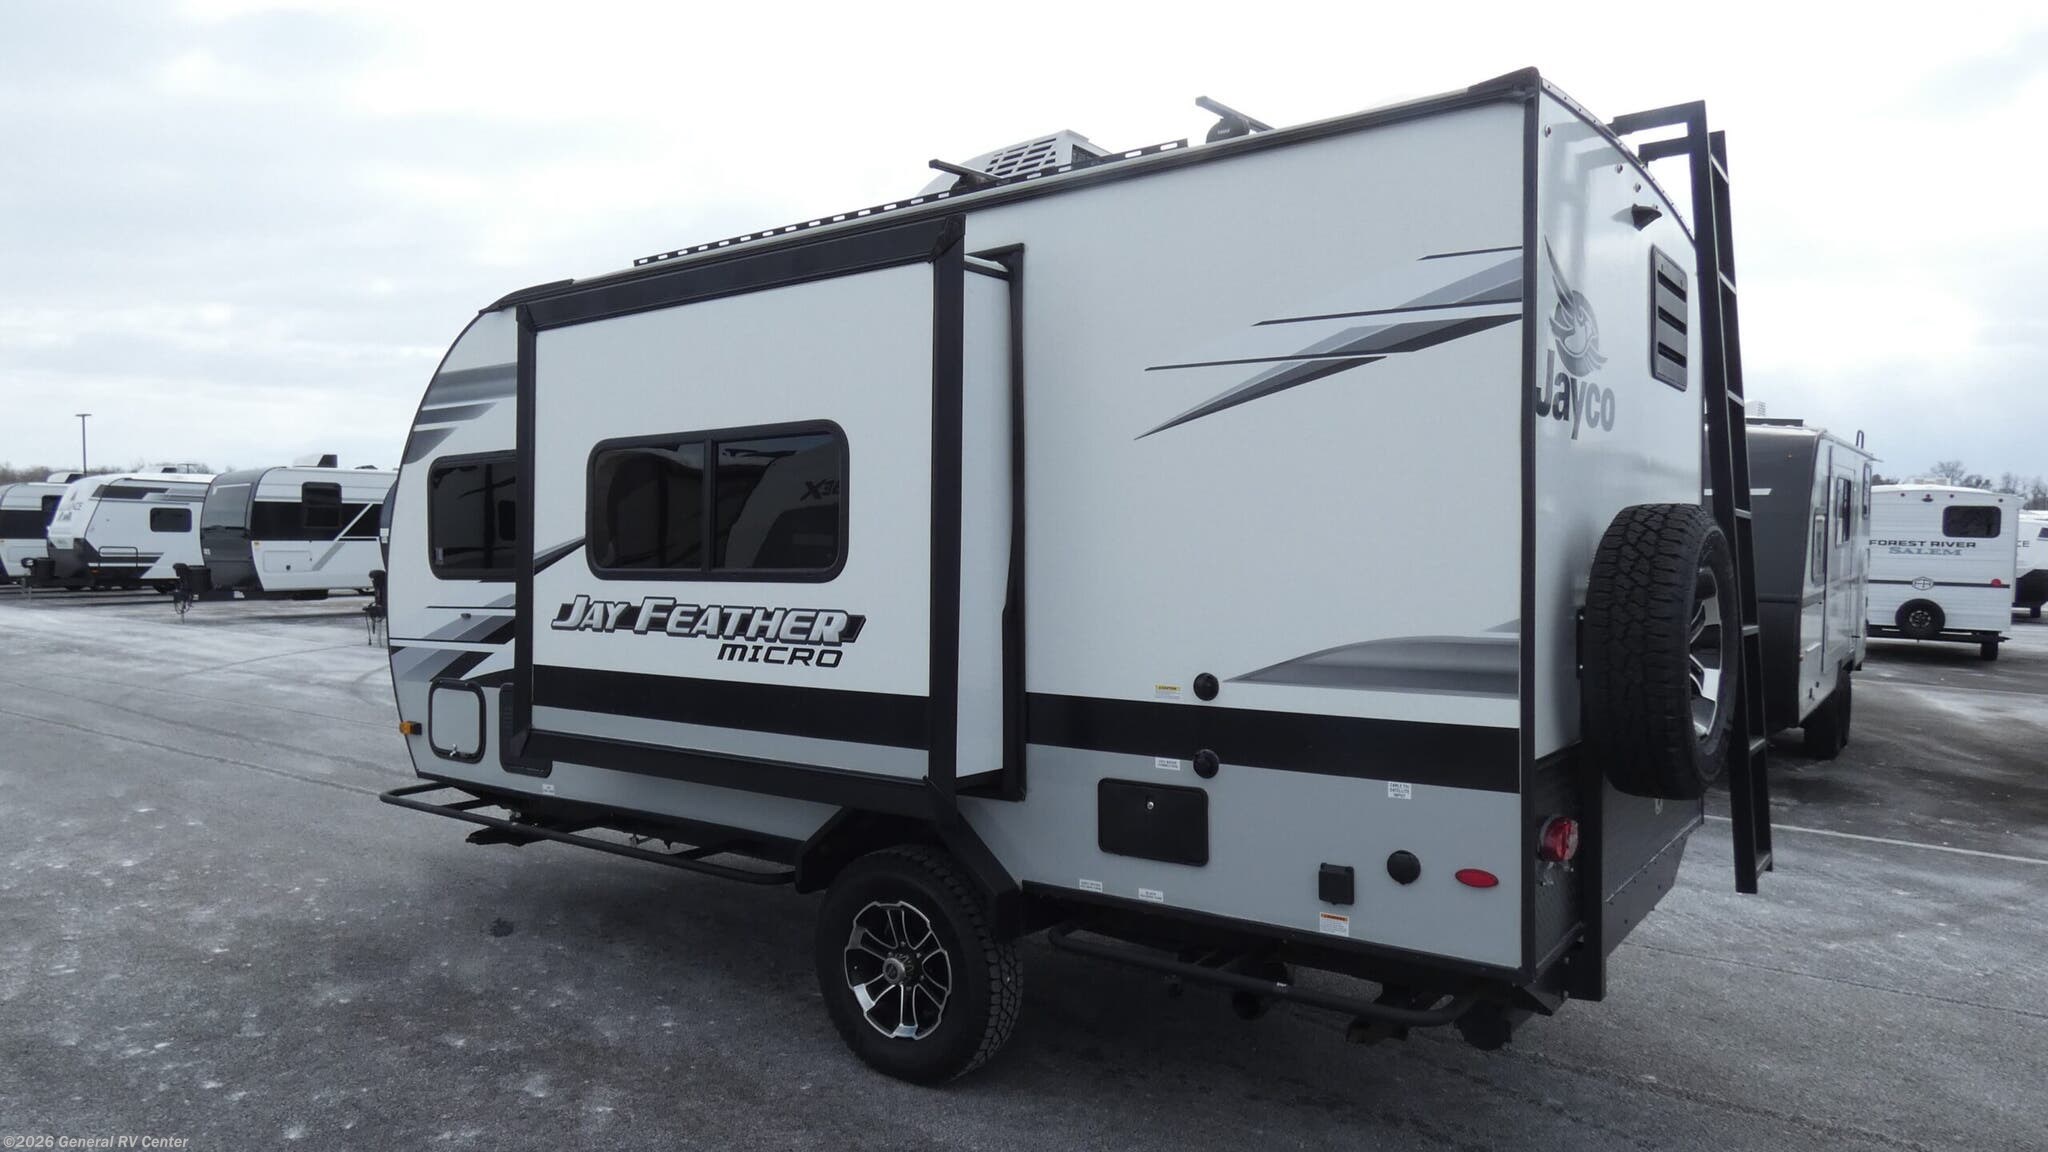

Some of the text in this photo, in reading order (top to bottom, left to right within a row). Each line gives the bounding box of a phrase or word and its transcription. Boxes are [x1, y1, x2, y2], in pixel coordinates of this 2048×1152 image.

[1535, 349, 1615, 440] Jayco
[1868, 539, 1927, 547] FOREST
[1888, 546, 1963, 556] SALEM
[551, 595, 849, 647] JAY FEATHER
[717, 643, 843, 668] MICRO
